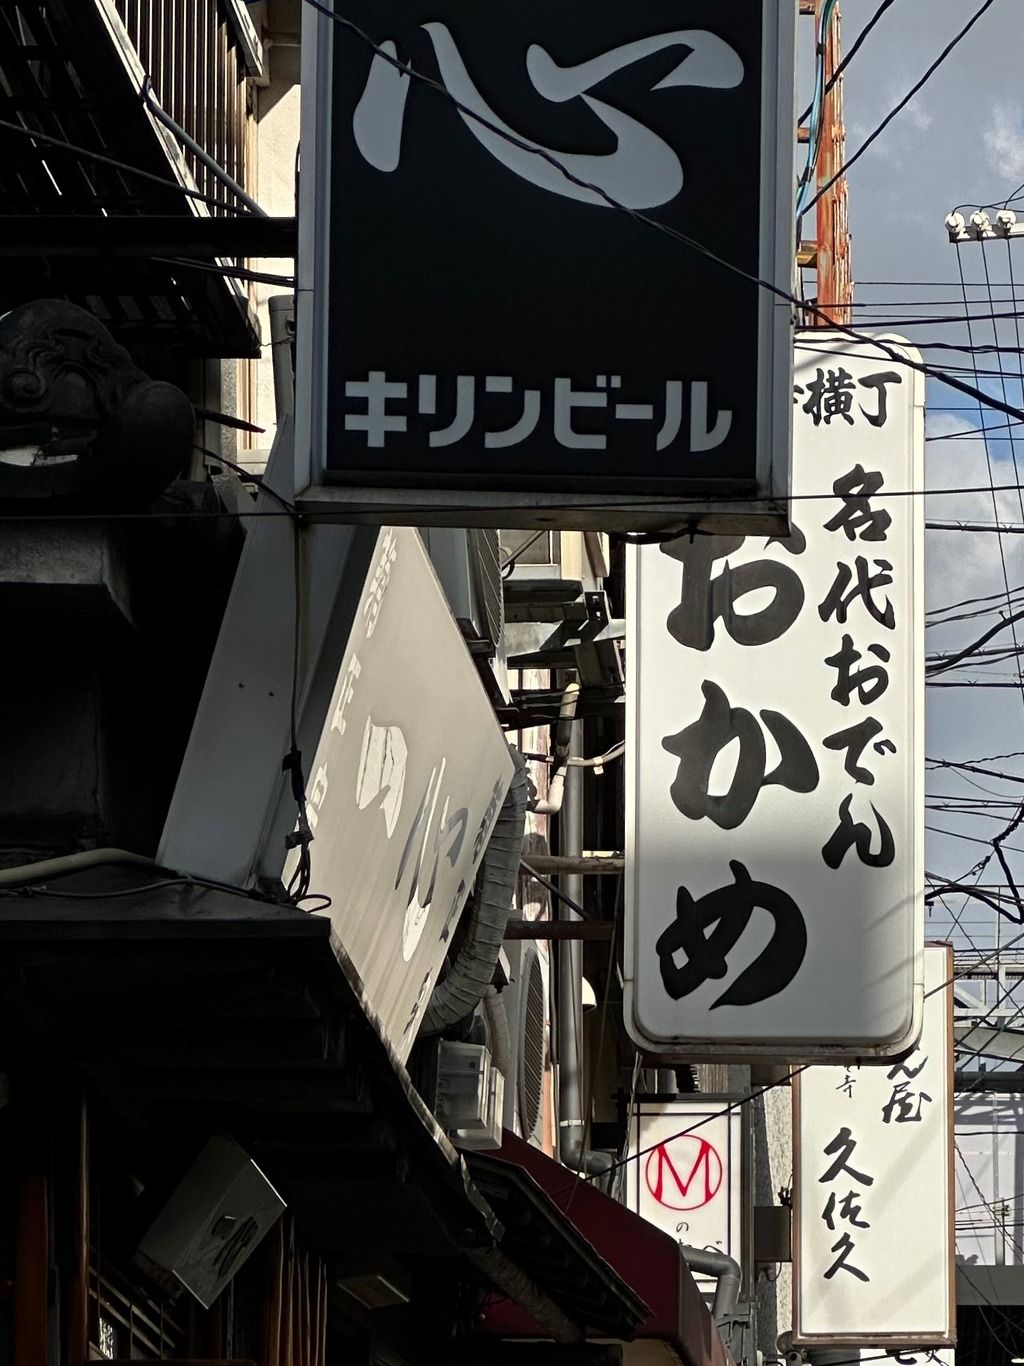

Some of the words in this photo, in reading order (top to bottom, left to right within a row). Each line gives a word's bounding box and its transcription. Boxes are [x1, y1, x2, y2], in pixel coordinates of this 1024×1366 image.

[345, 371, 733, 452] キリンビール
[793, 367, 903, 428] 横丁
[818, 464, 897, 870] 名代おでん
[656, 533, 819, 1010] おかめ
[655, 1142, 712, 1201] M
[819, 1126, 874, 1283] 久佐久
